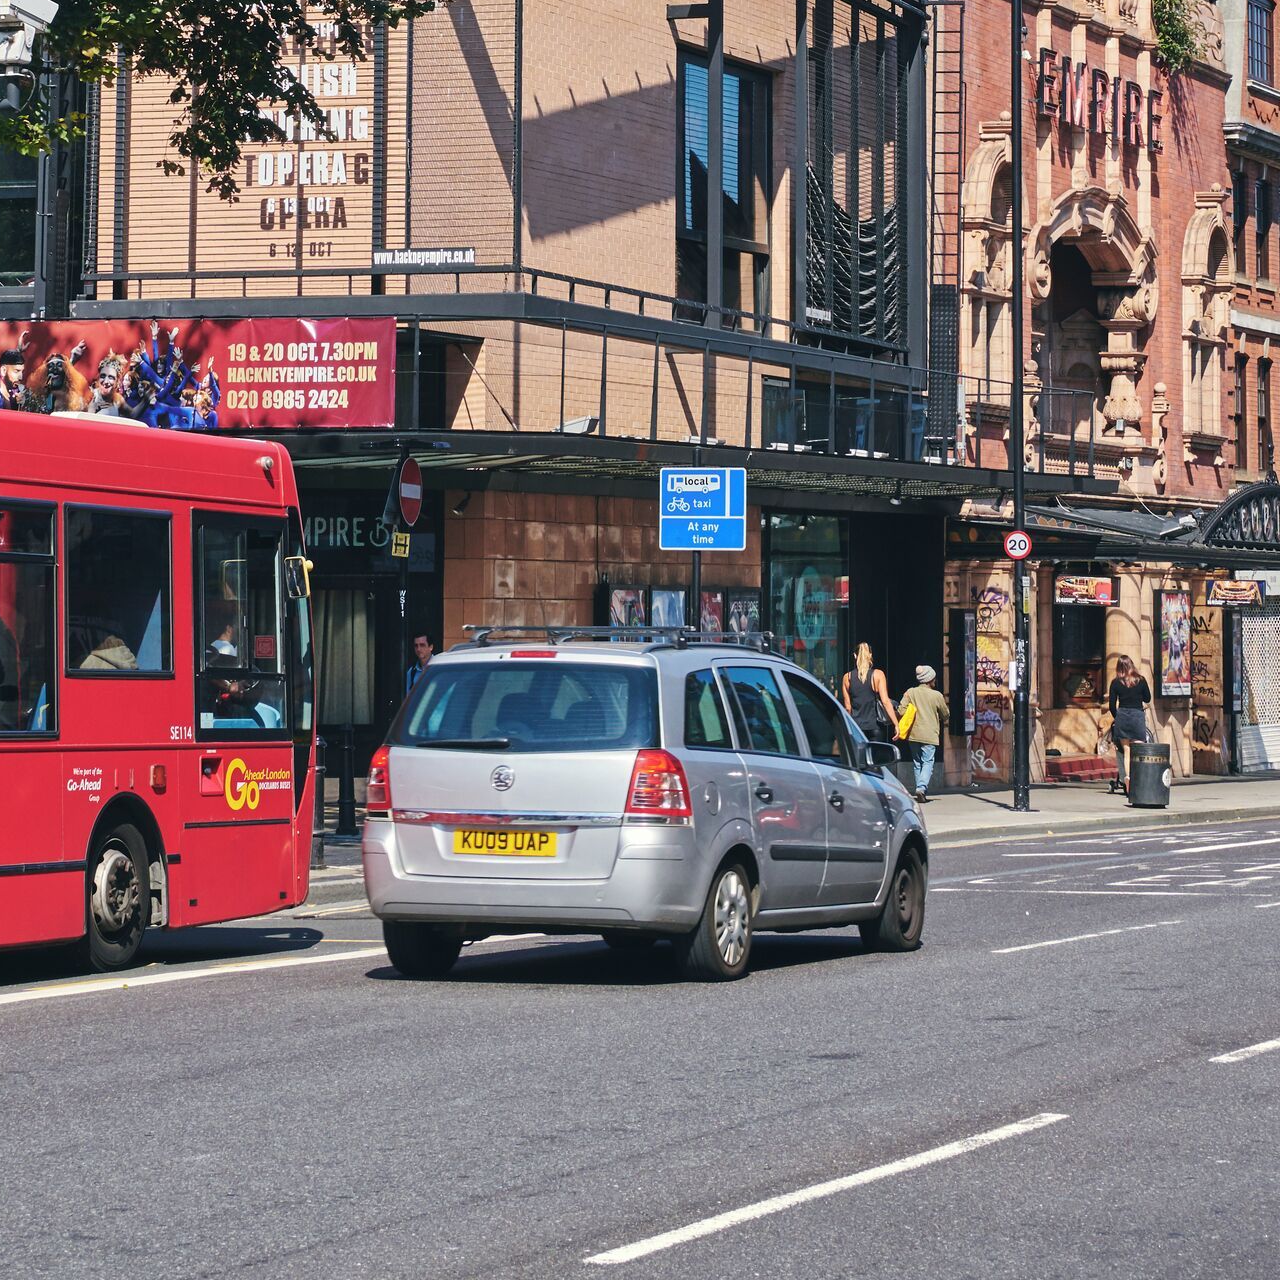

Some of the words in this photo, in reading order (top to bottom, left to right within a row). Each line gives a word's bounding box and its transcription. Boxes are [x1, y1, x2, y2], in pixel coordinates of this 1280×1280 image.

[1038, 47, 1163, 155] EMPIRE
[258, 150, 347, 186] OPERA
[307, 197, 331, 211] OCT
[374, 249, 475, 266] www.hackneyempire.co.uk
[228, 343, 247, 361] 19
[249, 346, 261, 361] &
[263, 343, 284, 361] 20
[287, 342, 319, 363] OCT,
[321, 342, 378, 361] 7.30PM
[227, 366, 377, 383] HACKNEYEMPIRE.CO.UK
[227, 390, 258, 409] 020
[262, 390, 305, 409] 8985
[308, 389, 349, 409] 2424
[684, 477, 709, 486] local
[693, 499, 712, 508] taxi
[687, 522, 699, 532] At
[702, 523, 720, 533] any
[394, 534, 408, 554] H
[692, 534, 714, 544] time
[1008, 540, 1027, 551] 20
[170, 725, 192, 740] SE114
[83, 768, 91, 777] part
[243, 769, 291, 780] Ahead-London
[67, 778, 102, 791] Go-Ahead
[225, 758, 260, 811] Go
[259, 781, 278, 790] DOCKLANDS
[279, 781, 291, 789] BUSES
[89, 794, 100, 803] Group
[461, 831, 508, 850] KU09
[514, 833, 550, 851] UAP
